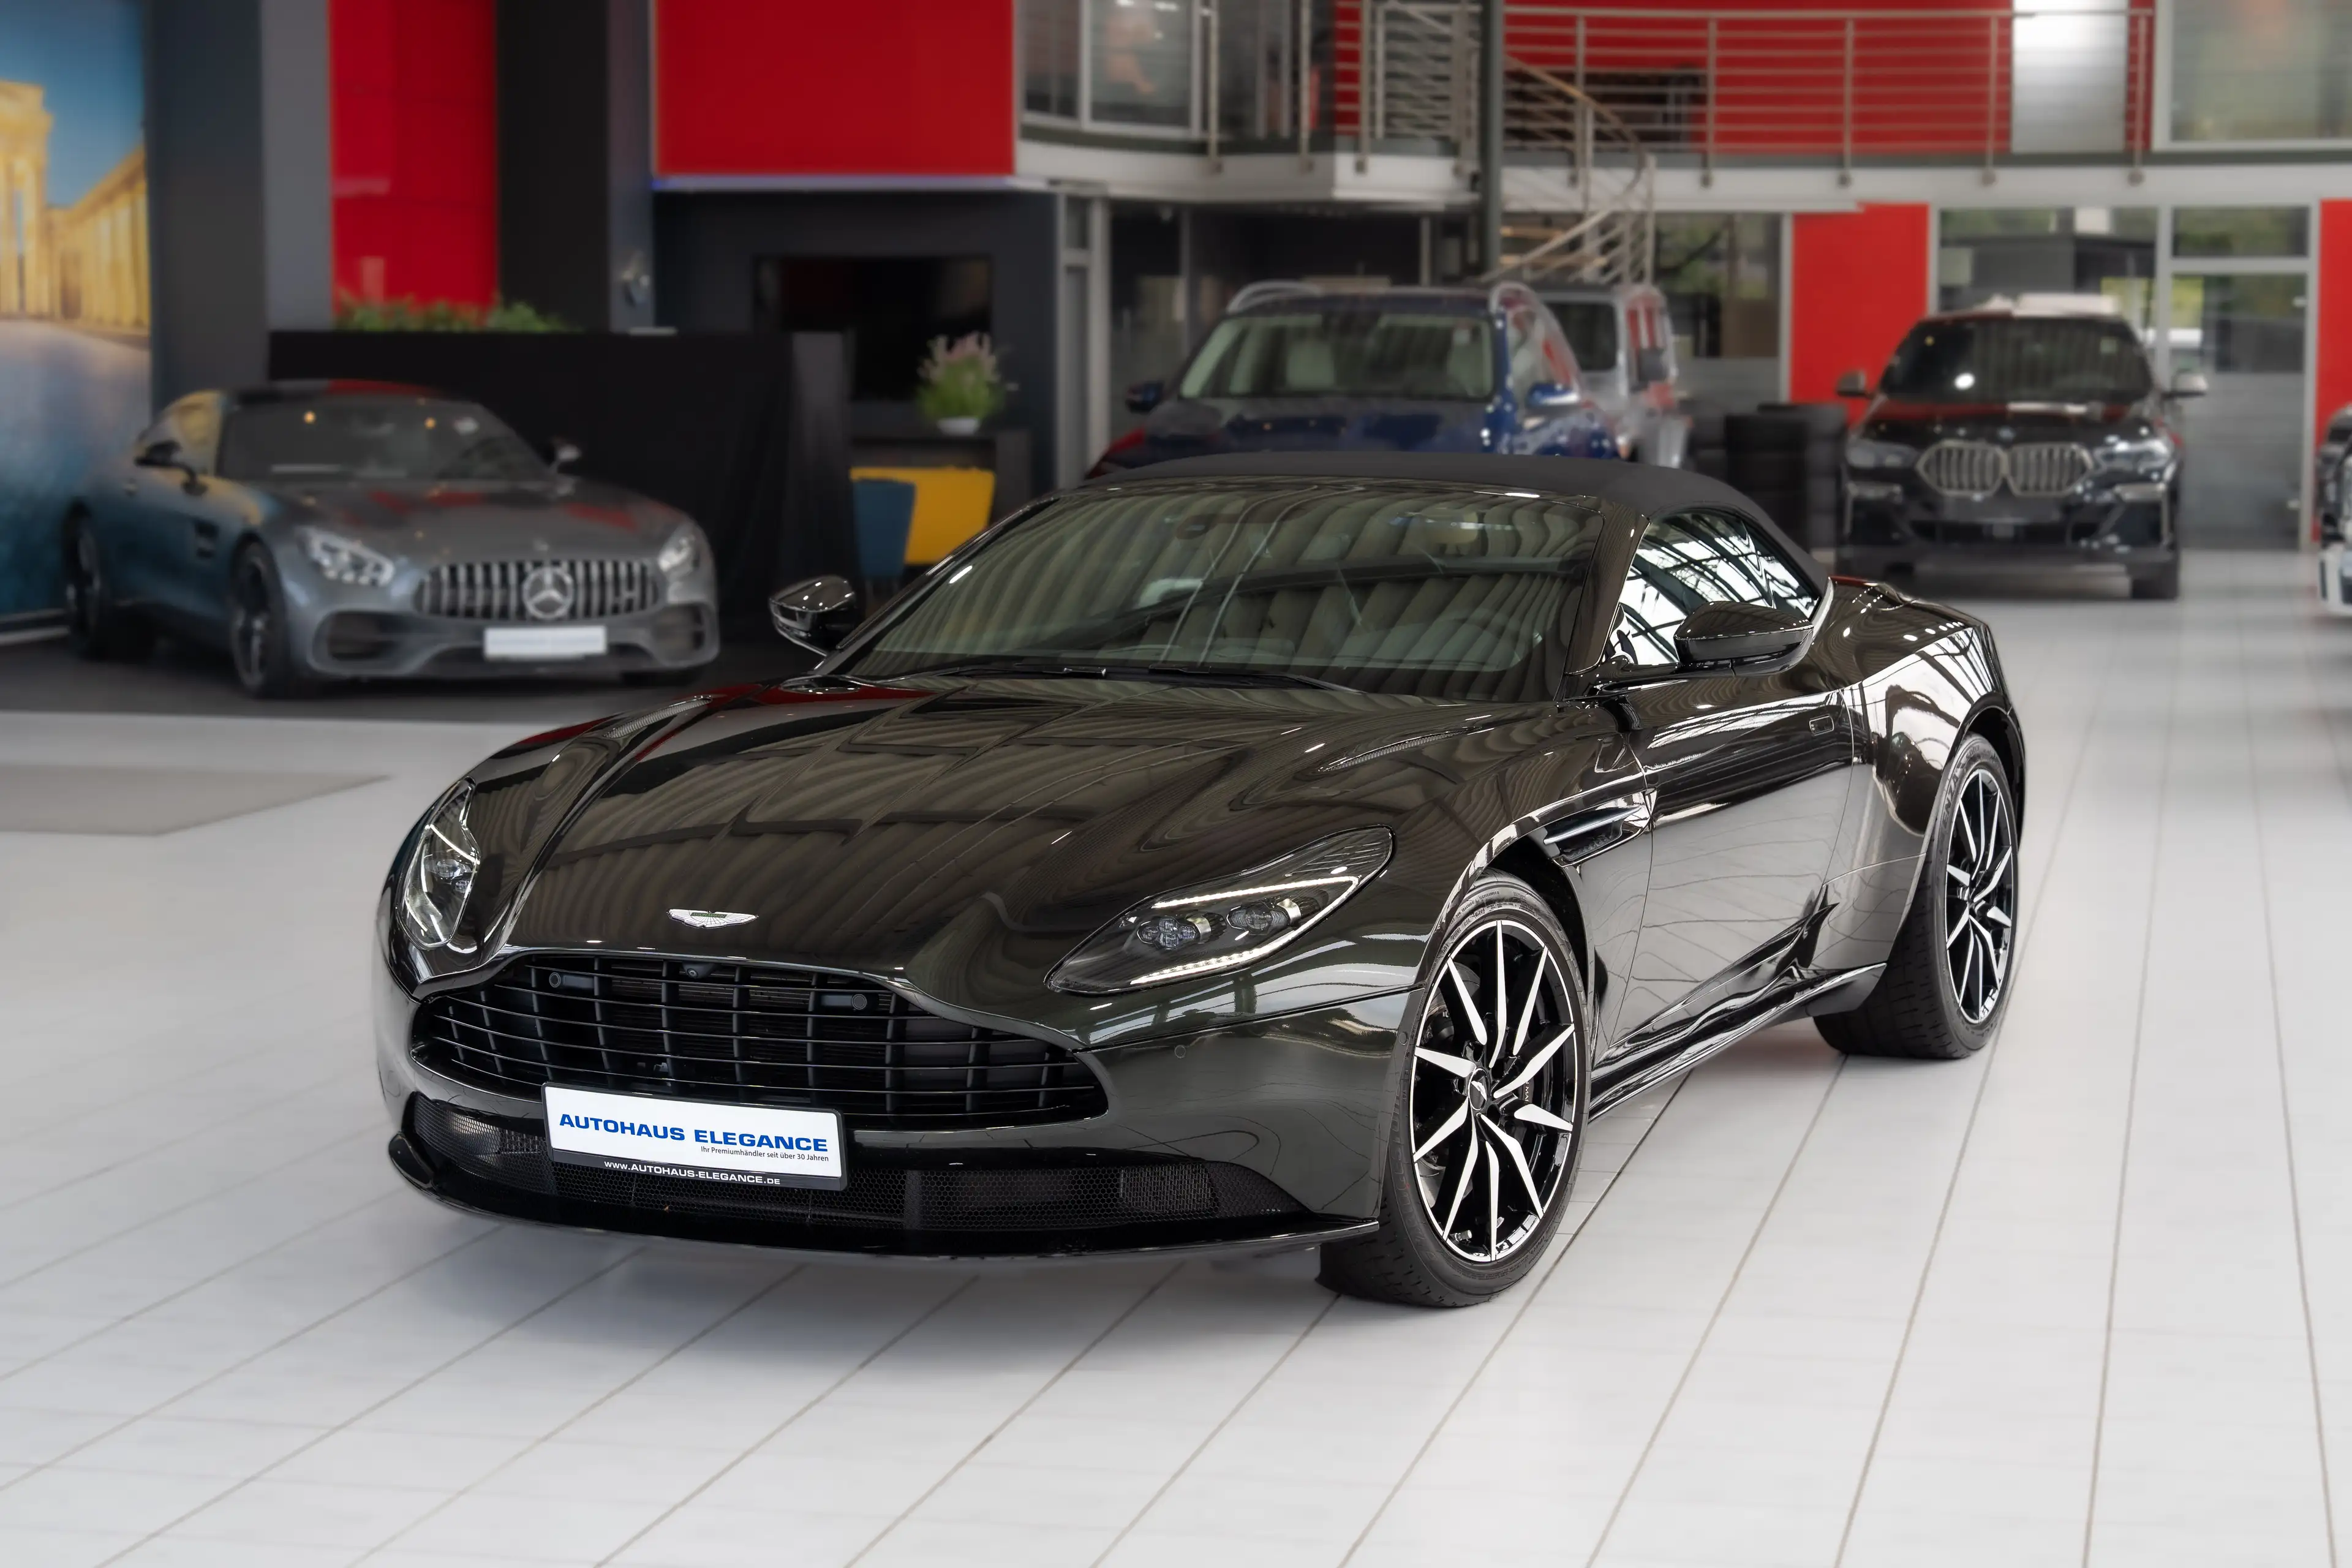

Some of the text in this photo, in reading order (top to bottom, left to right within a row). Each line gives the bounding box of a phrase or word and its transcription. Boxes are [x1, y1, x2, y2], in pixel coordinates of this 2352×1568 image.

[560, 1113, 828, 1152] AUTOHAUS ELEGANCE
[711, 1147, 765, 1157] Premiumhändler
